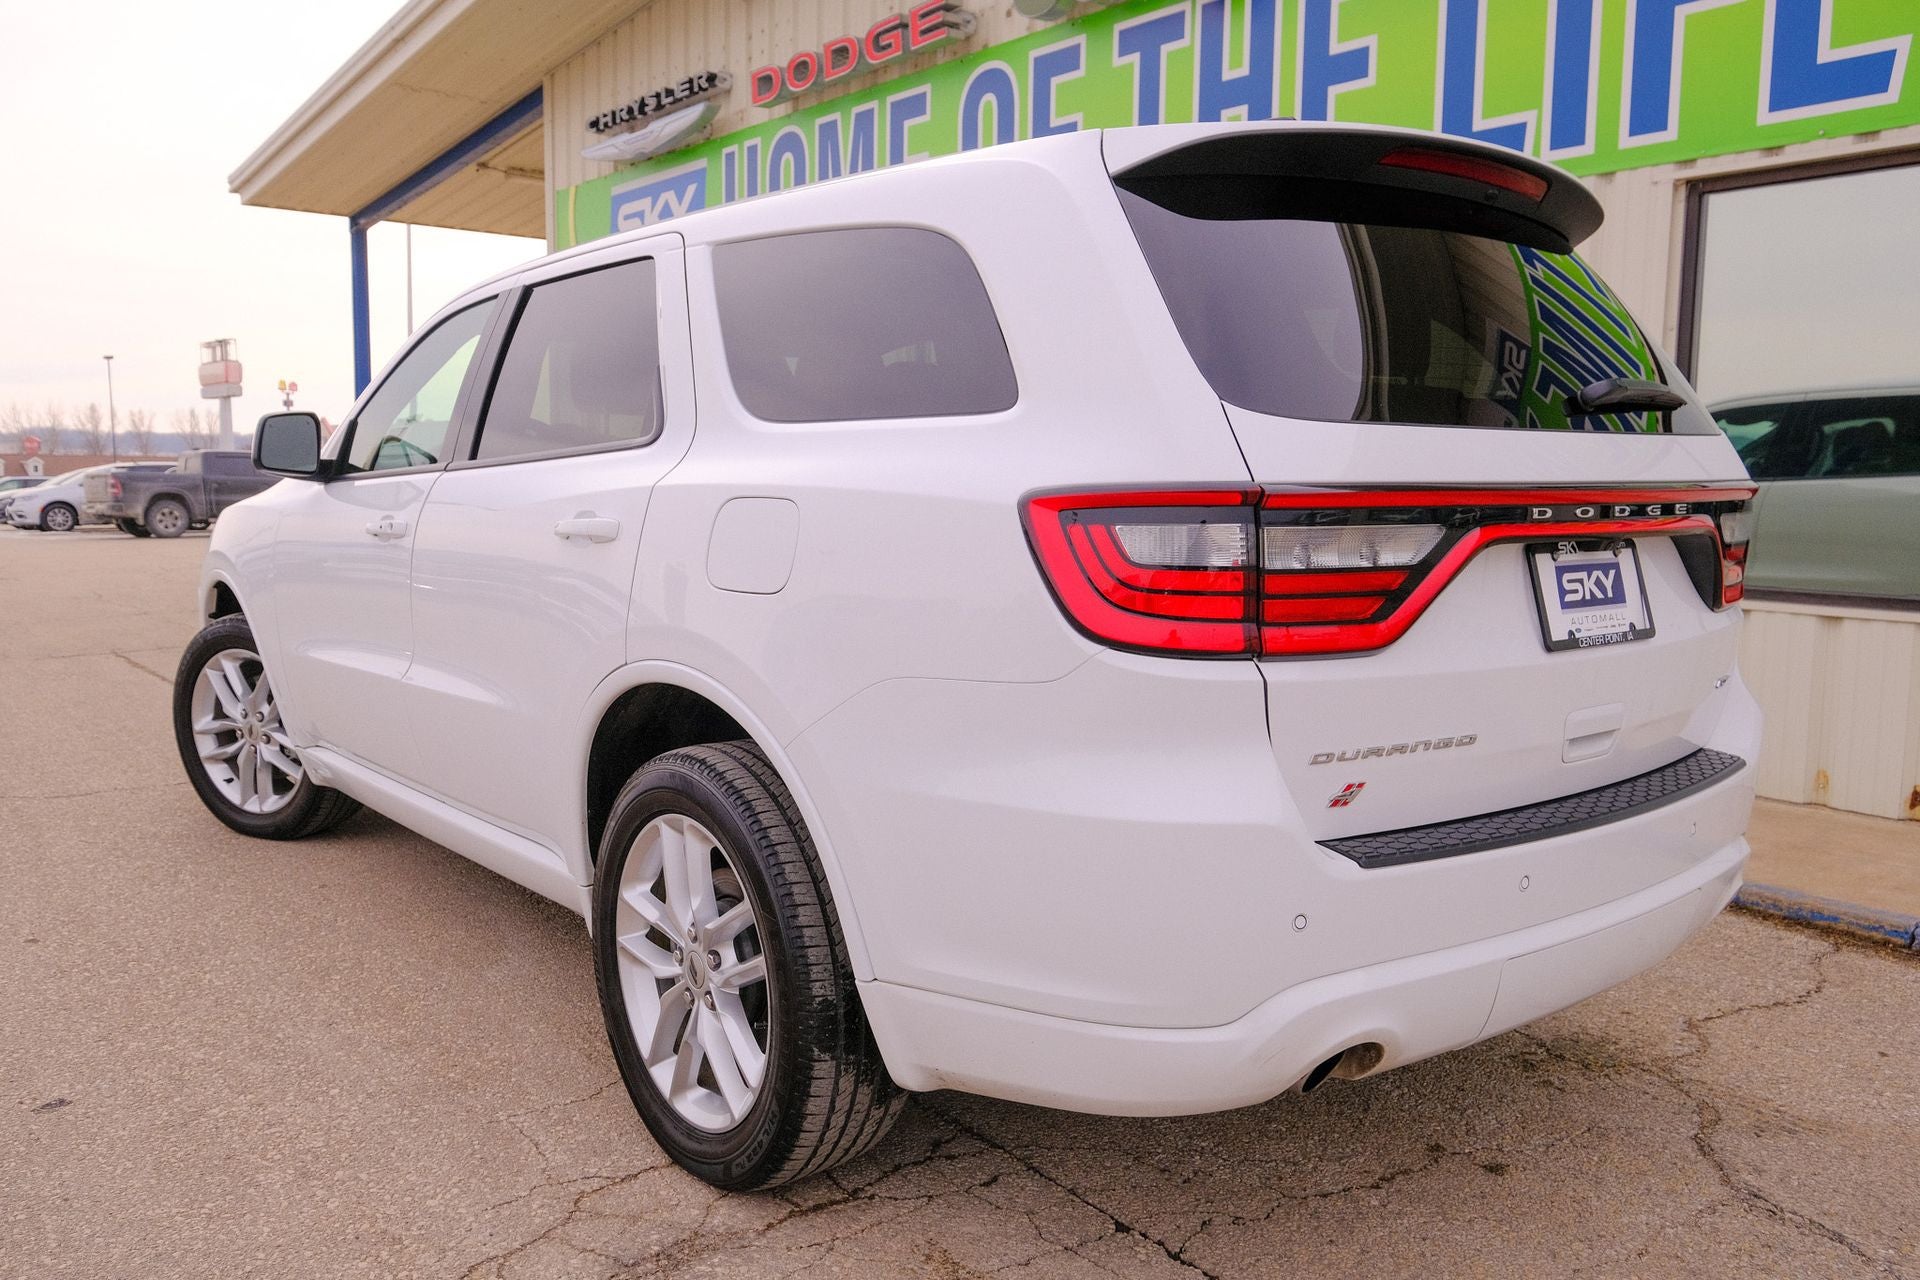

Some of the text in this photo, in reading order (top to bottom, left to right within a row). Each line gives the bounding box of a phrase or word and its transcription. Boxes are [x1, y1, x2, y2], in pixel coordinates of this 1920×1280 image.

[751, 0, 947, 105] DODGE
[958, 34, 1086, 152] OF
[1112, 0, 1377, 127] THE
[586, 71, 715, 133] CHRYSLER
[617, 182, 699, 232] SKY
[1532, 503, 1688, 519] DODGE
[1562, 569, 1616, 602] SKY
[1571, 611, 1627, 625] AUTOMALL
[1579, 635, 1604, 648] CENTER
[1626, 631, 1634, 641] IA
[1309, 733, 1478, 766] DURANGO
